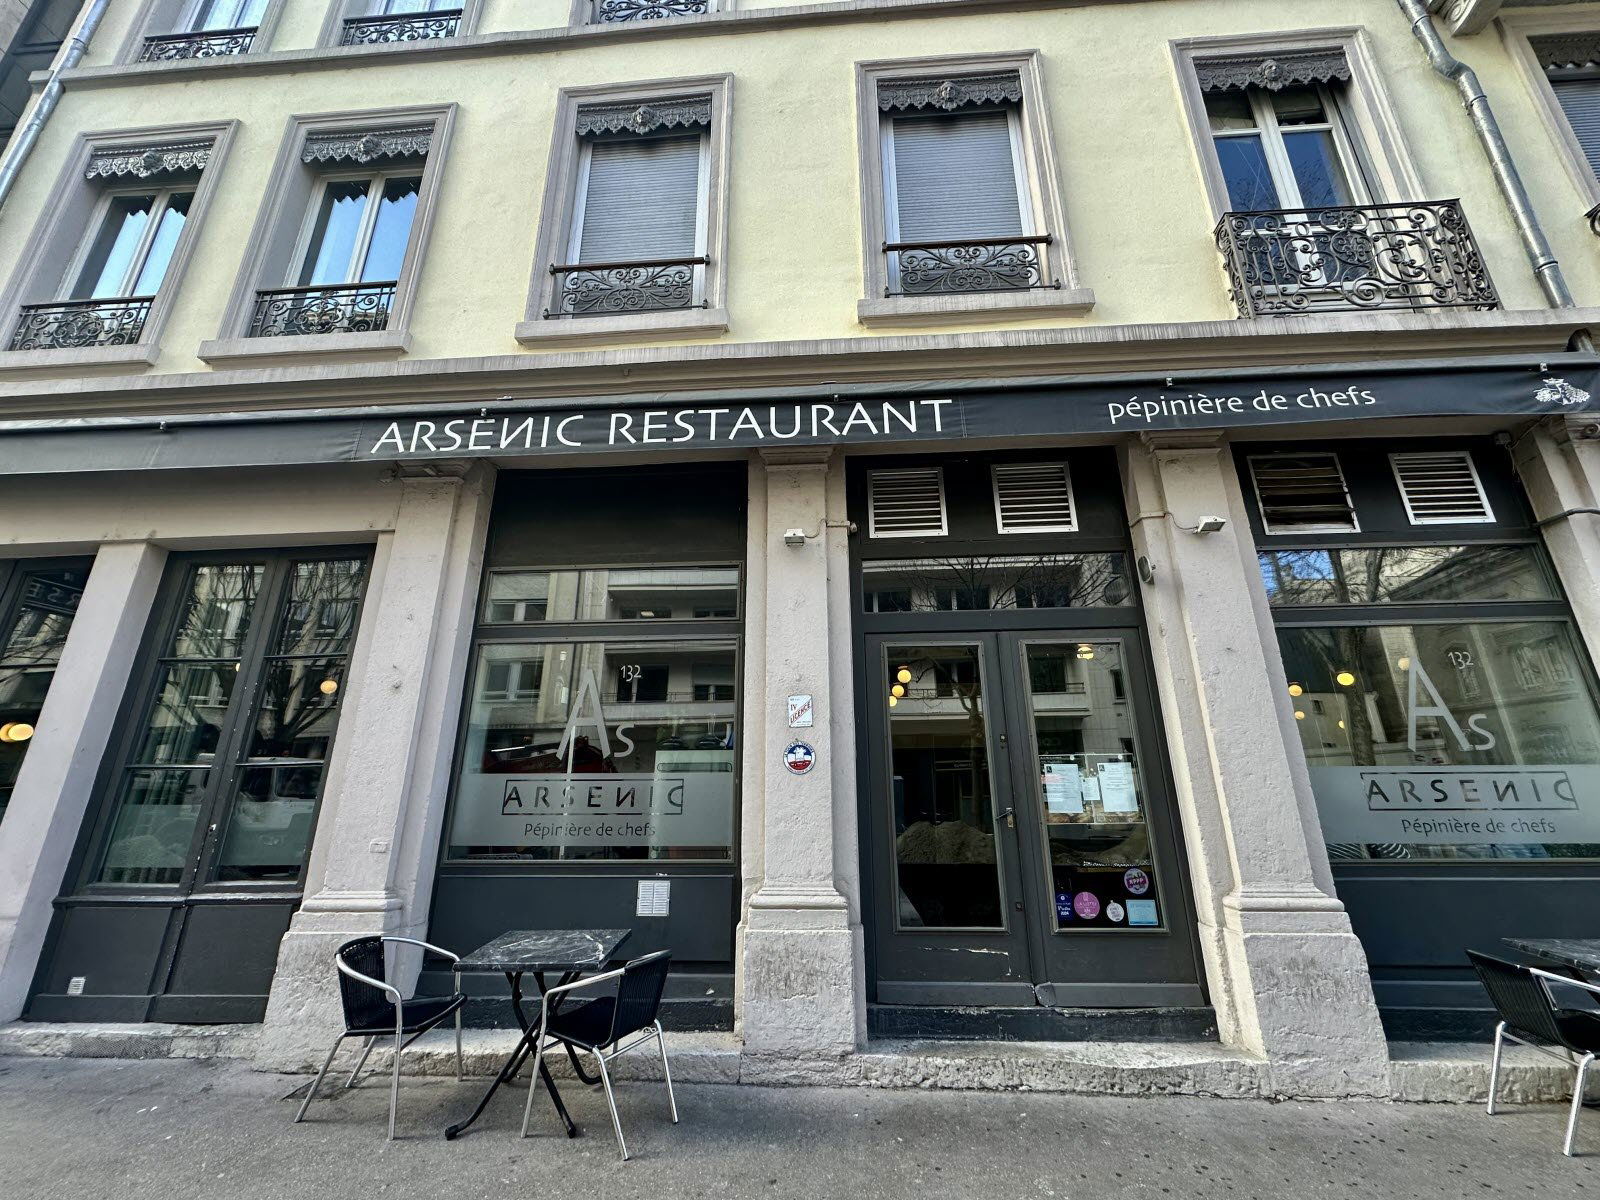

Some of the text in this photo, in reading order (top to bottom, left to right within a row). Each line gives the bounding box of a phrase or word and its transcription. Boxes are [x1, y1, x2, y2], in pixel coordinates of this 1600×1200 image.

[1108, 386, 1376, 424] pépinière de chefs
[608, 399, 953, 445] RESTAURANT
[1447, 651, 1474, 669] 132
[620, 664, 642, 682] 132
[595, 822, 613, 837] de
[617, 822, 656, 837] chefs
[1401, 817, 1556, 837] Pépinière de chefs
